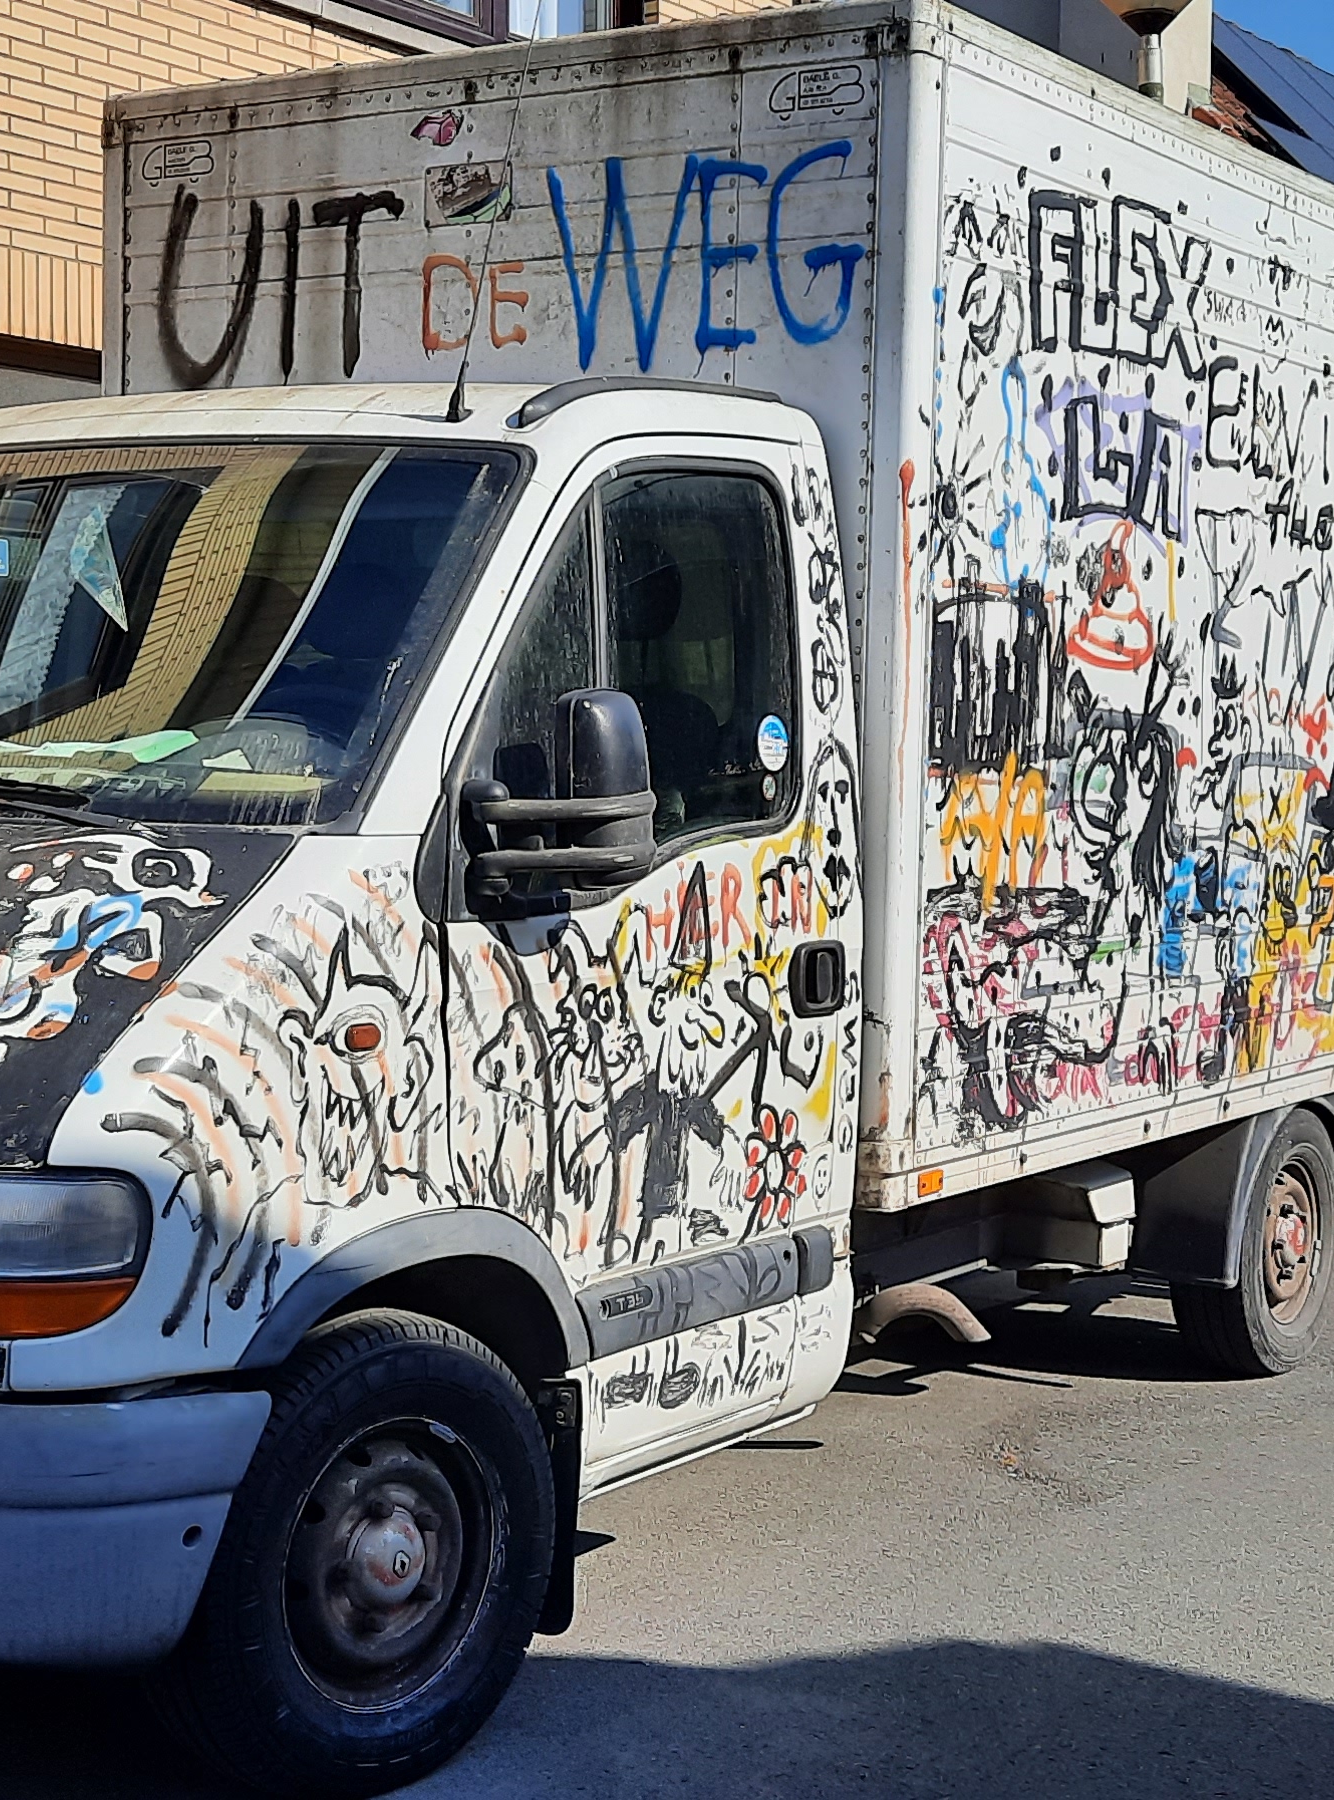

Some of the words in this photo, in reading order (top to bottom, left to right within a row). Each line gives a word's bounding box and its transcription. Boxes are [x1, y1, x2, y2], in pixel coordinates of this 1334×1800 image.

[156, 184, 404, 388] UIT
[422, 253, 529, 356] DE
[546, 140, 864, 374] WEG
